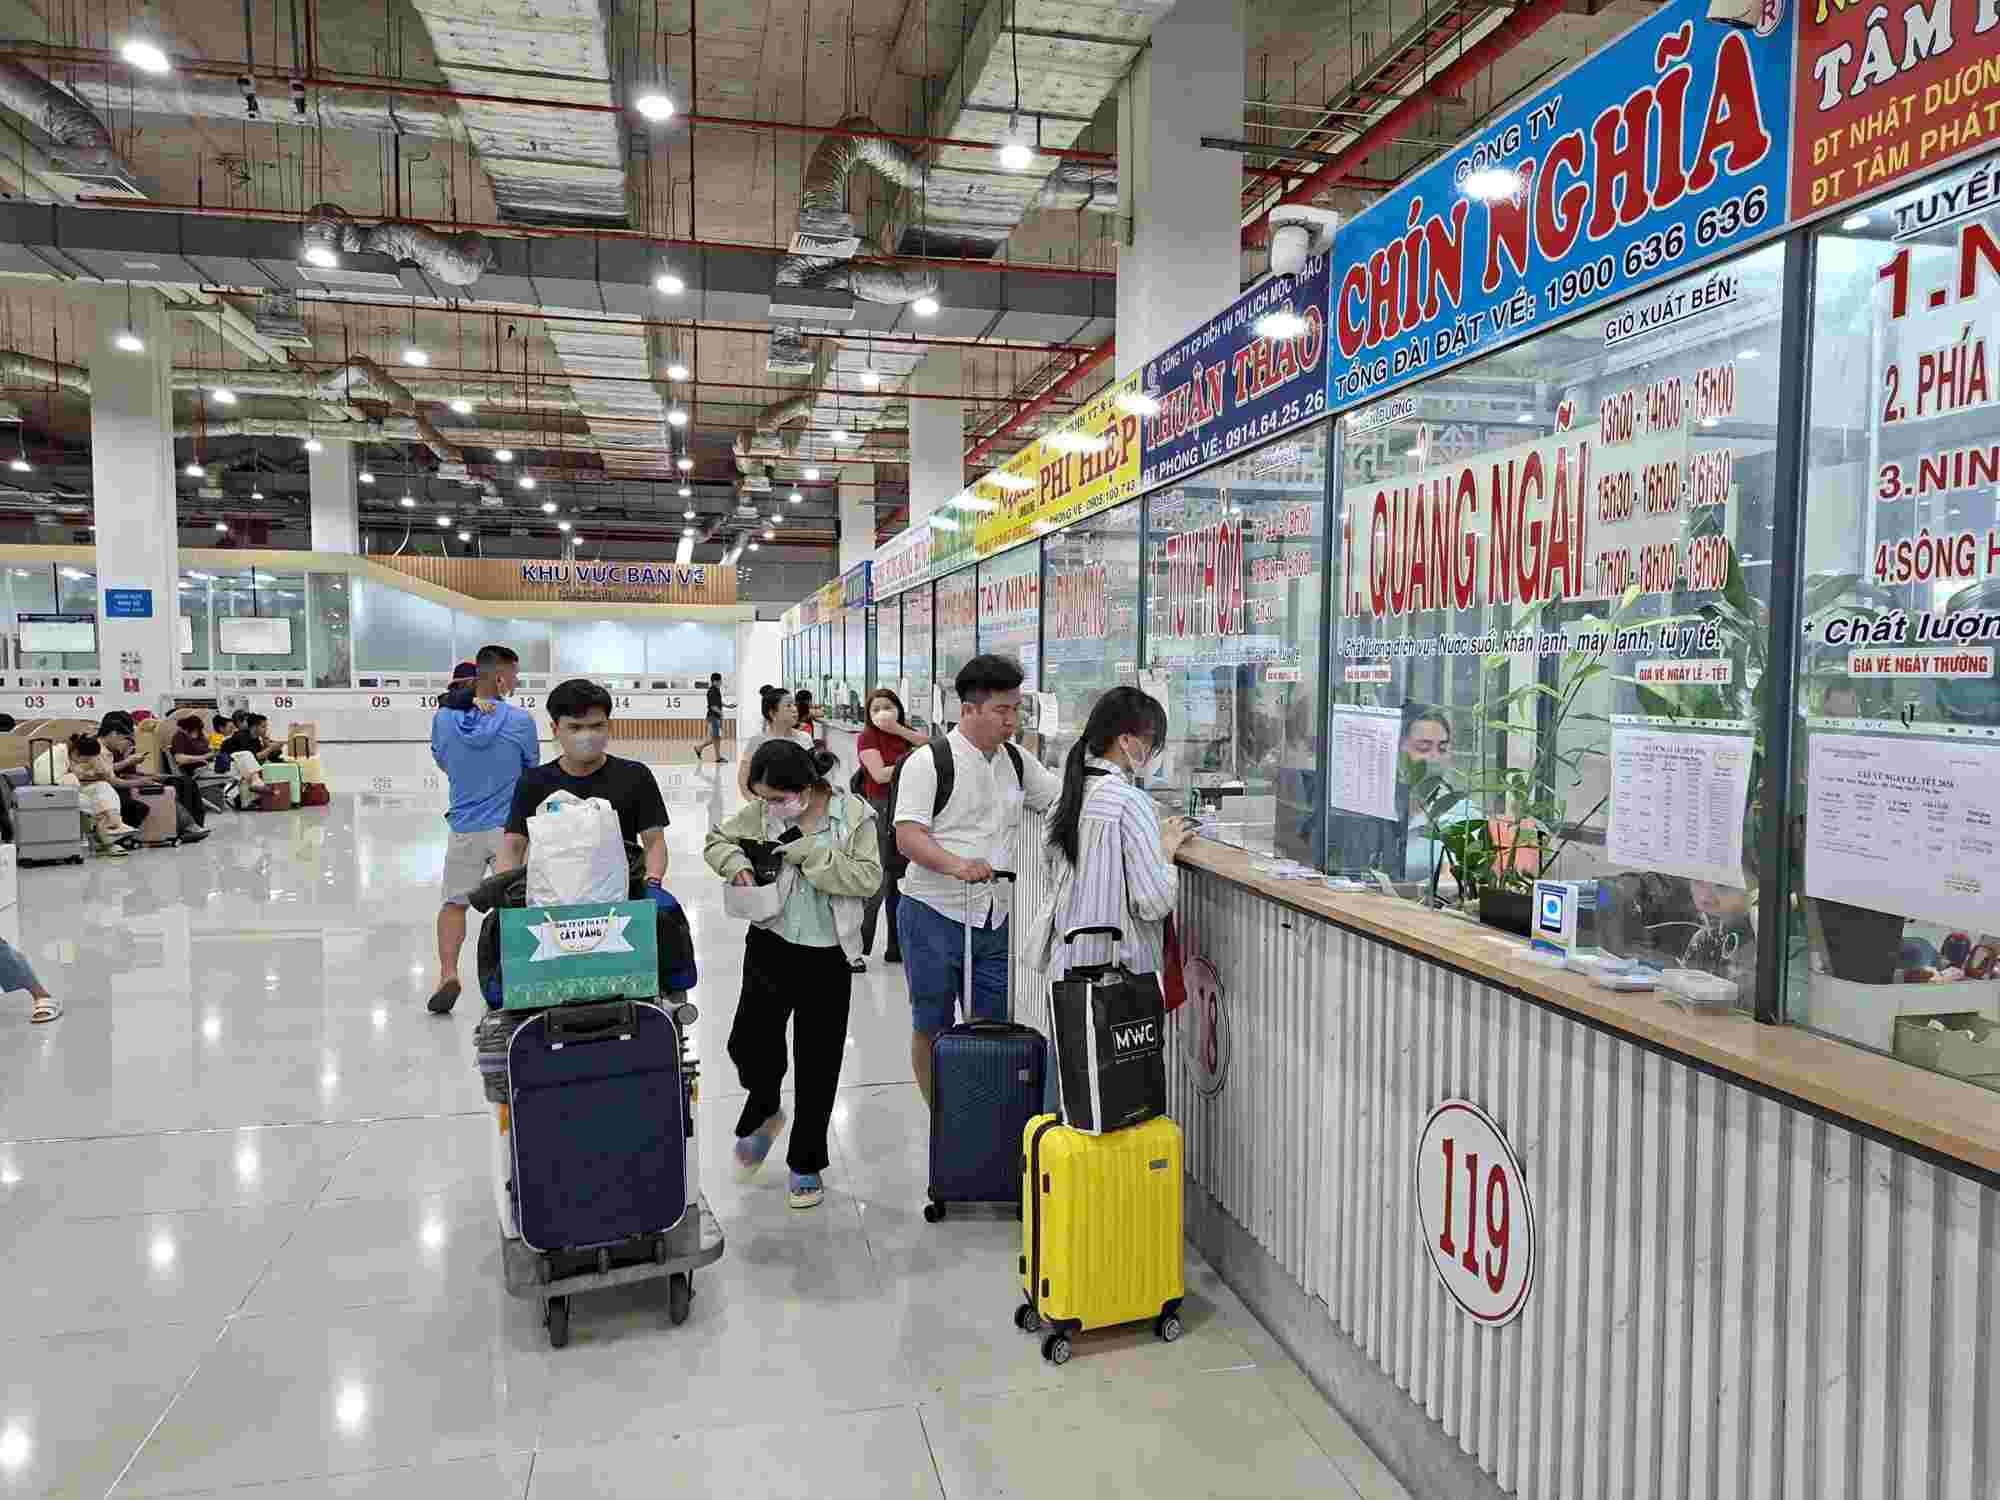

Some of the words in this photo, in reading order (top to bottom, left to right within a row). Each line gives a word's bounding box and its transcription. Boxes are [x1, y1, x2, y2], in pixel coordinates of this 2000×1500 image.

[1814, 0, 1954, 111] TÂM
[1456, 124, 1520, 184] CÔNG
[1528, 96, 1562, 143] TY
[1811, 169, 1846, 207] ĐT
[1853, 141, 1910, 188] TÂM
[1920, 100, 2000, 160] PHÁT
[1813, 129, 1845, 166] ĐT
[1850, 94, 1917, 148] NHẬT
[1338, 196, 1468, 359] CHÍN
[1484, 22, 1772, 292] NGHĨA
[1336, 356, 1387, 399] TỔNG
[1393, 336, 1429, 375] ĐÀI
[1435, 312, 1485, 357] ĐẶT
[1490, 286, 1536, 333] VÉ:
[1546, 256, 1615, 310] 1900
[1623, 223, 1684, 277] 636
[1697, 186, 1767, 246] 636
[1640, 289, 1685, 328] XUẤT
[1692, 272, 1737, 309] BẾN:
[1917, 321, 1987, 416] PHÍA
[1601, 392, 1633, 443] 13h00
[1646, 377, 1681, 432] 14h00
[1694, 365, 1736, 418] 15h00
[1159, 445, 1199, 478] PHÒNG
[1226, 389, 1324, 449] 0914.64.25.26
[1040, 451, 1072, 505] PHI
[1598, 472, 1632, 520] 15h30
[1643, 461, 1679, 513] 16h00
[1370, 423, 1477, 617] QUẢNG
[1489, 403, 1588, 606] NGÃI
[521, 565, 569, 582] KHU
[1640, 543, 1676, 592] 18h00
[1687, 537, 1728, 591] 19h00
[1577, 627, 1611, 657] máy
[1614, 626, 1655, 656] lạnh,
[1681, 627, 1694, 657] y
[1825, 610, 1907, 644] Chất
[24, 695, 45, 708] 03
[75, 695, 95, 708] 04
[371, 695, 390, 708] 09
[519, 696, 536, 708] 12
[615, 696, 630, 708] 14
[665, 696, 681, 708] 15
[1115, 1023, 1154, 1050] MWC
[1440, 1138, 1509, 1294] 119
